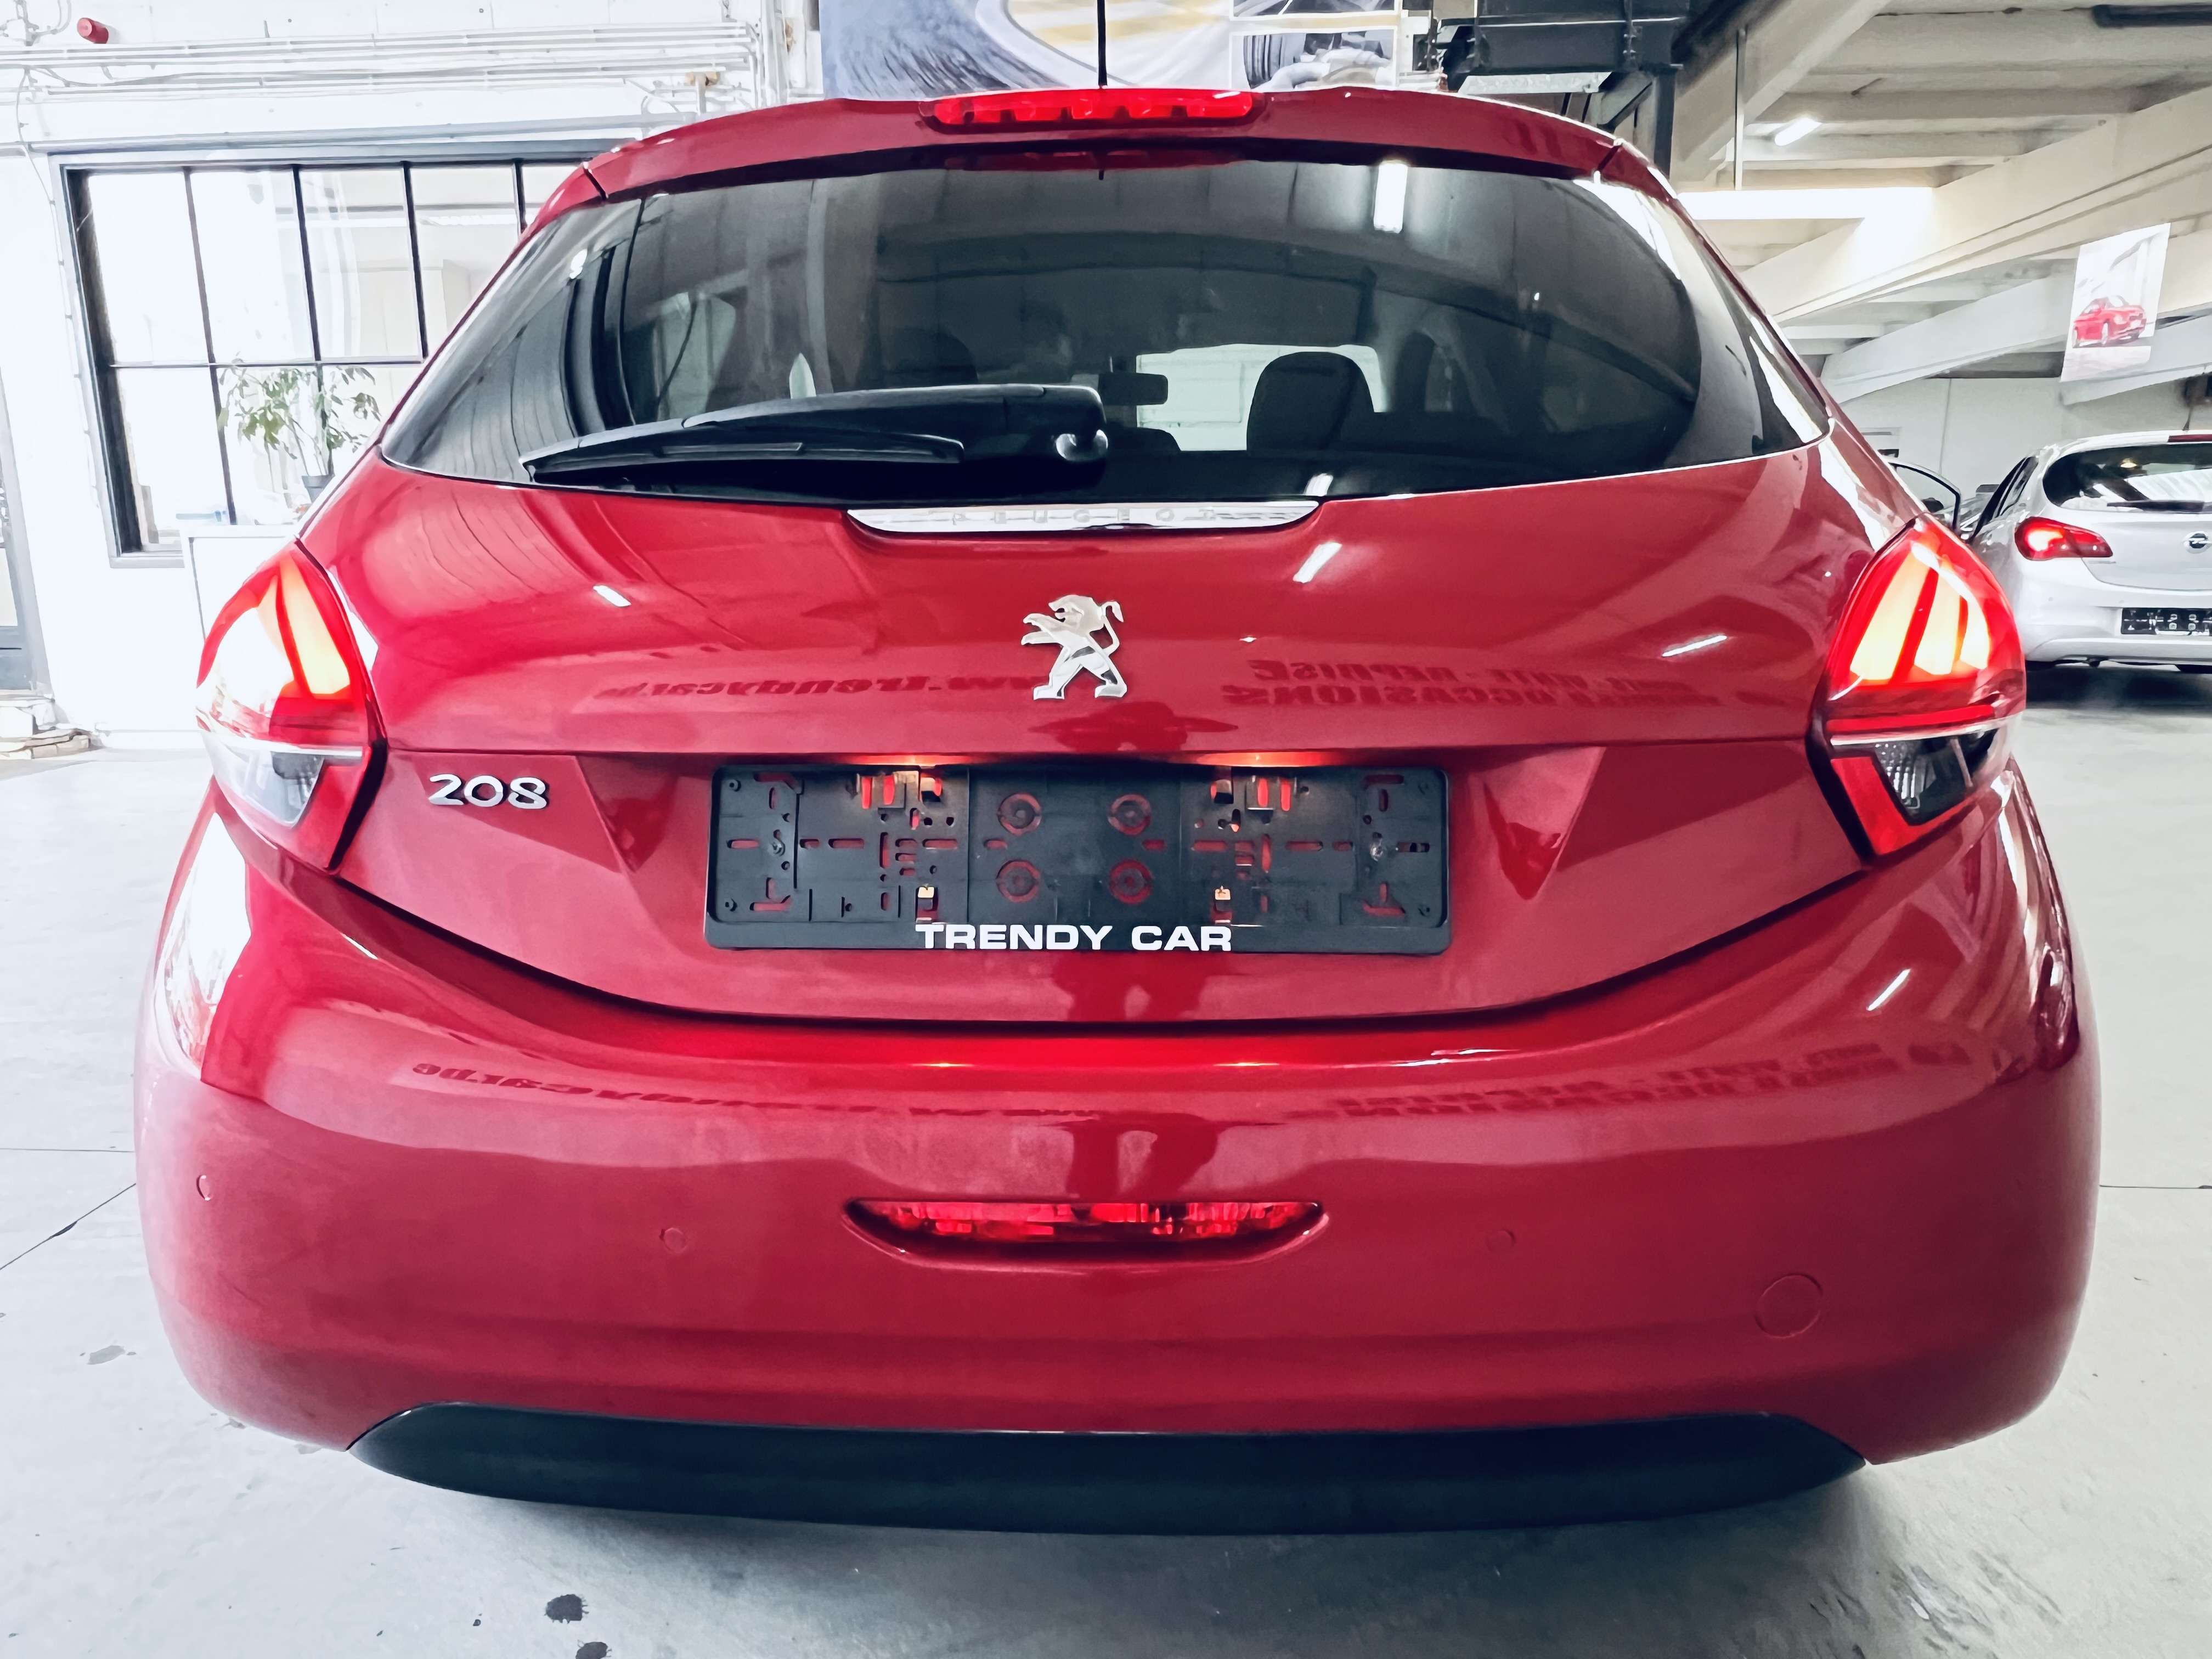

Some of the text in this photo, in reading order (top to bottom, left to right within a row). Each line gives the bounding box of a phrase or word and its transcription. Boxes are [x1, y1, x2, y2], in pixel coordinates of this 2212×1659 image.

[428, 774, 547, 810] 208
[915, 924, 1232, 951] TRENDY CAR
